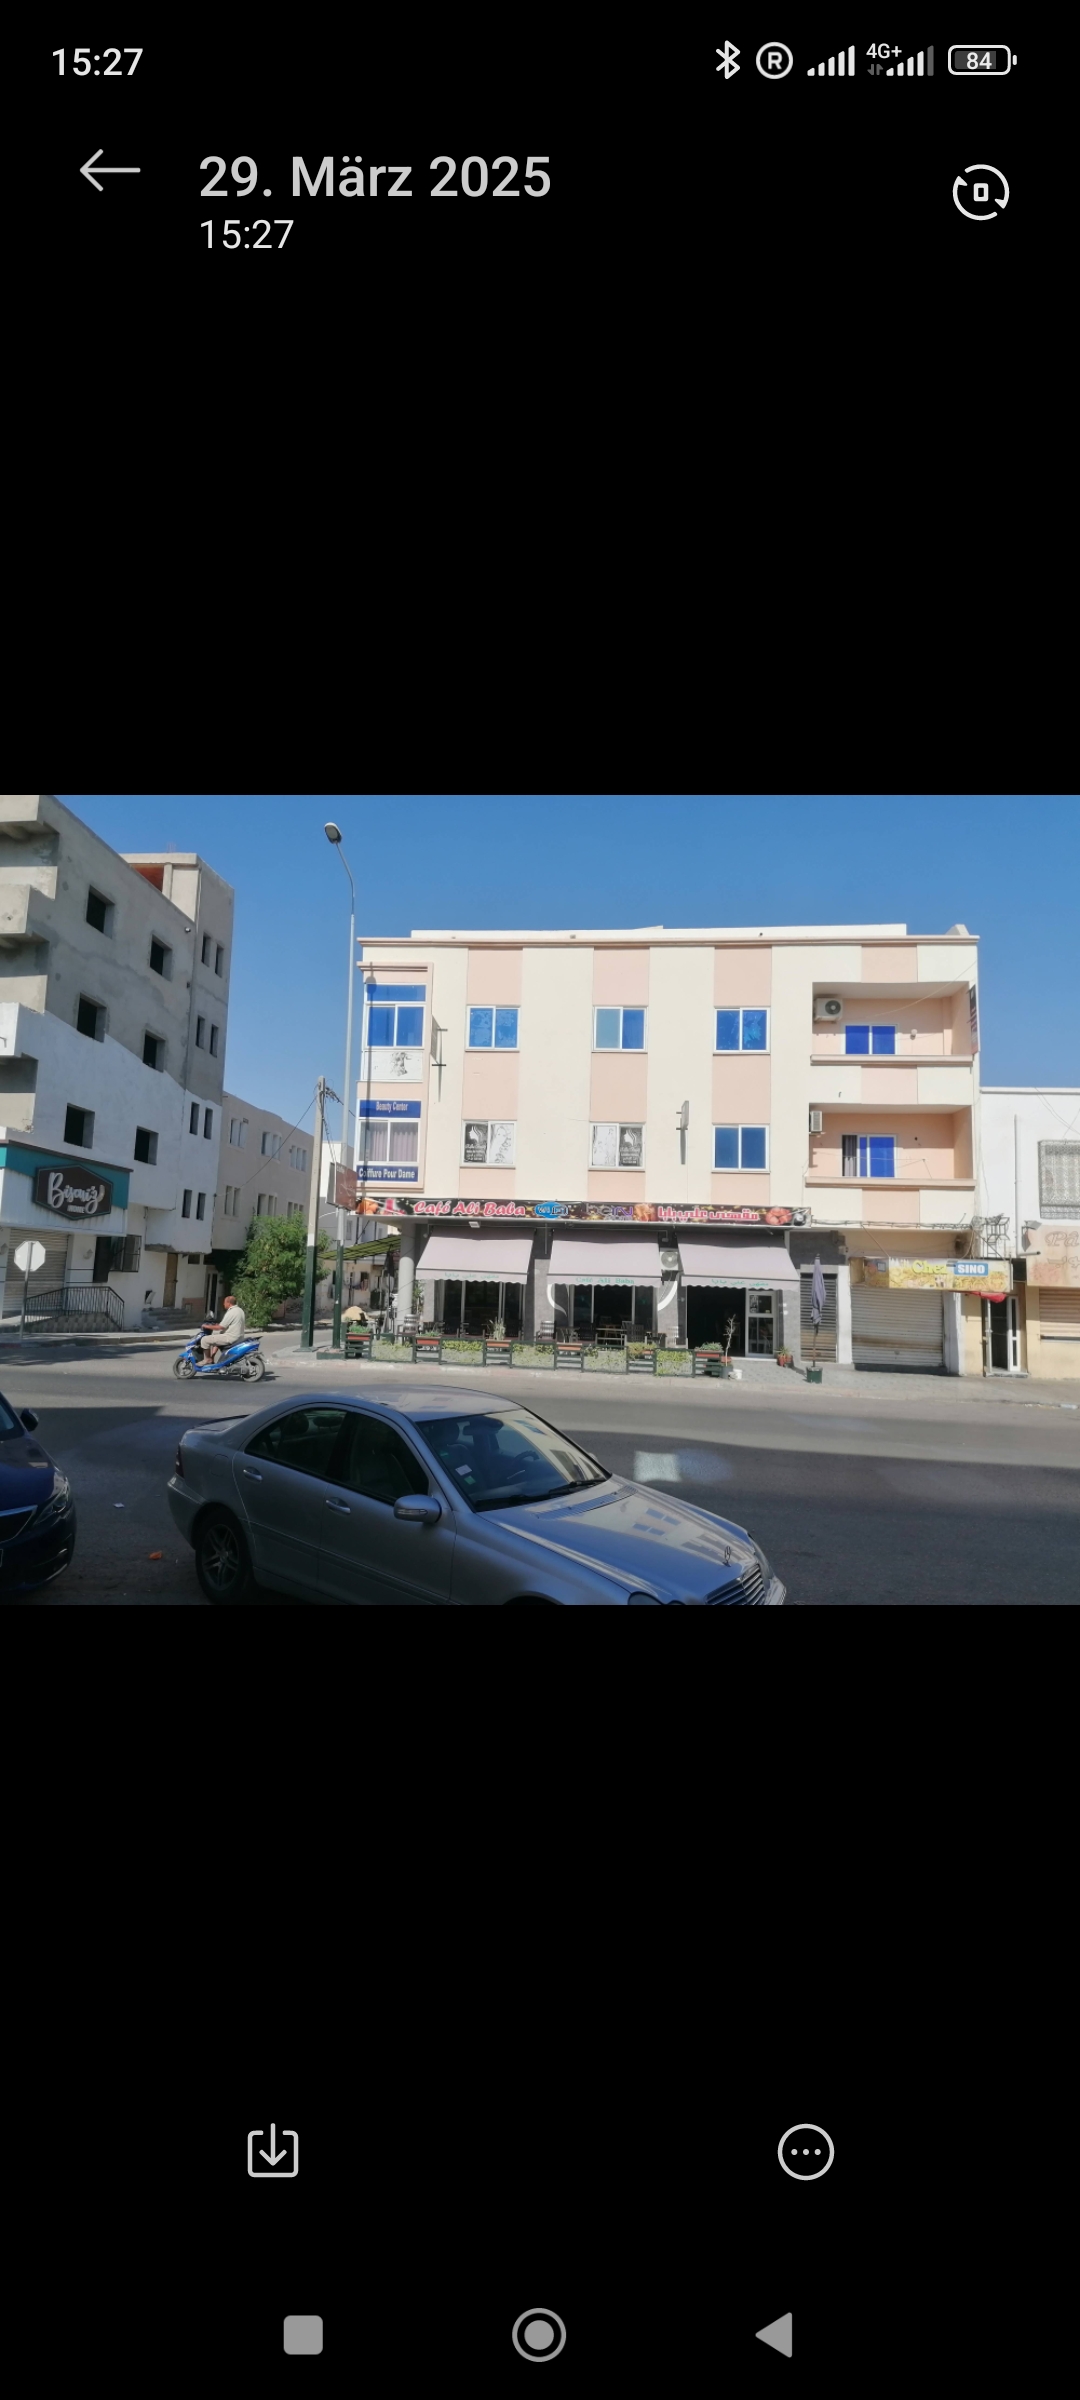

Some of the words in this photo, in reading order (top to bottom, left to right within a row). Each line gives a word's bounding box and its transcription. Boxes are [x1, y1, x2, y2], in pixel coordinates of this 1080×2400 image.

[376, 1101, 392, 1113] Beauty
[392, 1101, 408, 1111] Center
[358, 1167, 382, 1178] Coiffure
[383, 1168, 397, 1178] Pour
[398, 1169, 415, 1179] Dame
[413, 1200, 450, 1216] Café
[452, 1201, 480, 1215] Ali
[483, 1201, 526, 1216] Baba
[658, 1206, 677, 1222] بابا
[912, 1259, 948, 1275] Chez
[957, 1264, 986, 1274] SINO
